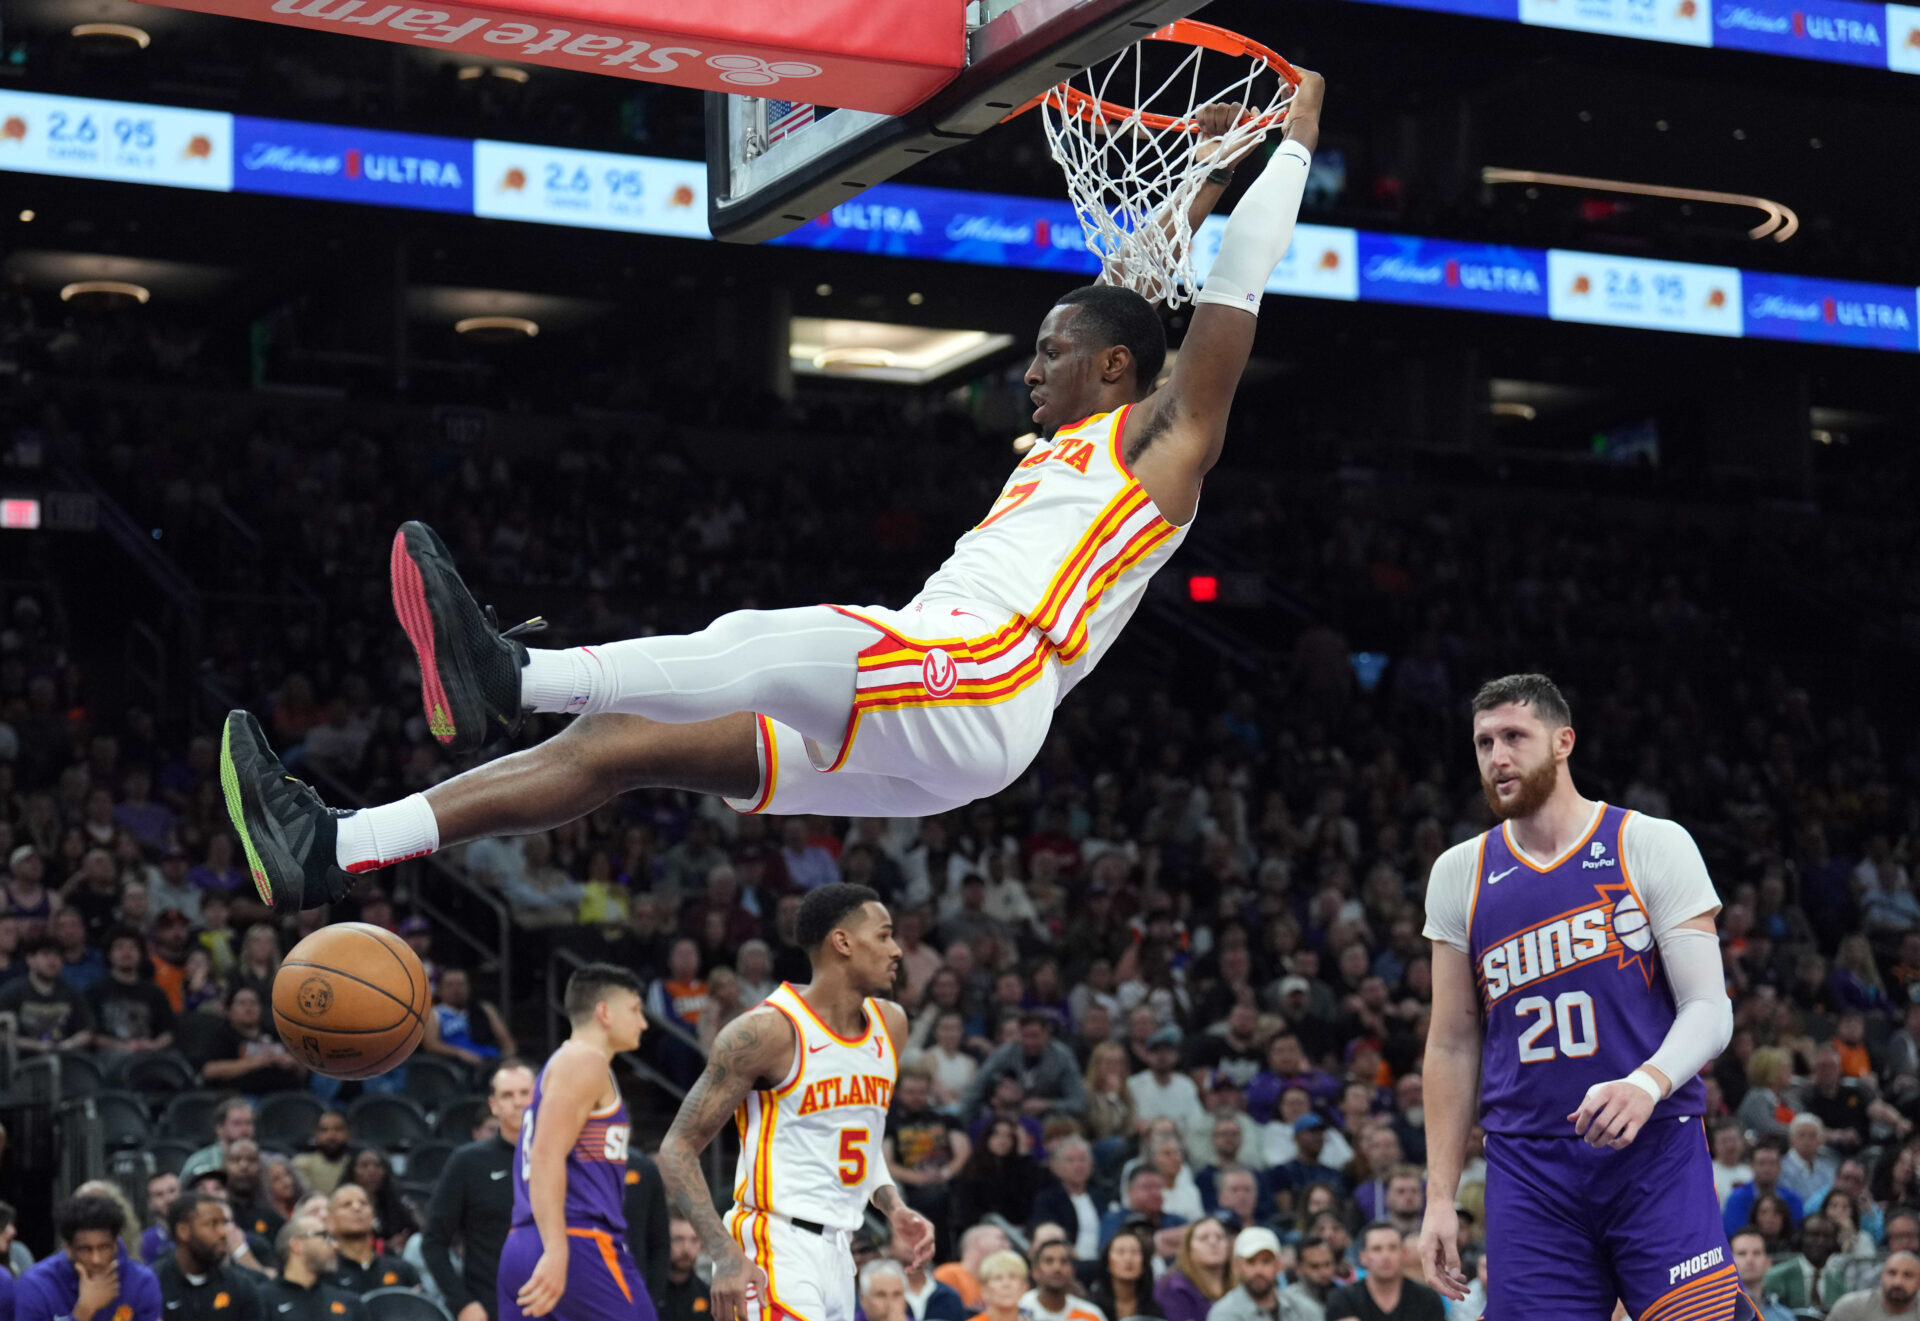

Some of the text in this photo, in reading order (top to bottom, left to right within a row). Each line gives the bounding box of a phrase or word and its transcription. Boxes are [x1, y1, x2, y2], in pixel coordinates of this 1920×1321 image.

[1806, 14, 1880, 47] ULTRA
[114, 118, 155, 149] 95
[364, 152, 462, 188] ULTRA
[832, 202, 923, 235] ULTRA
[1460, 263, 1541, 295] ULTRA
[1836, 301, 1910, 331] ULTRA
[973, 479, 1042, 530] 7
[1582, 858, 1615, 869] PayPal
[1515, 990, 1599, 1063] 20
[838, 1128, 869, 1186] 5
[1669, 1246, 1724, 1285] PHOENIX
